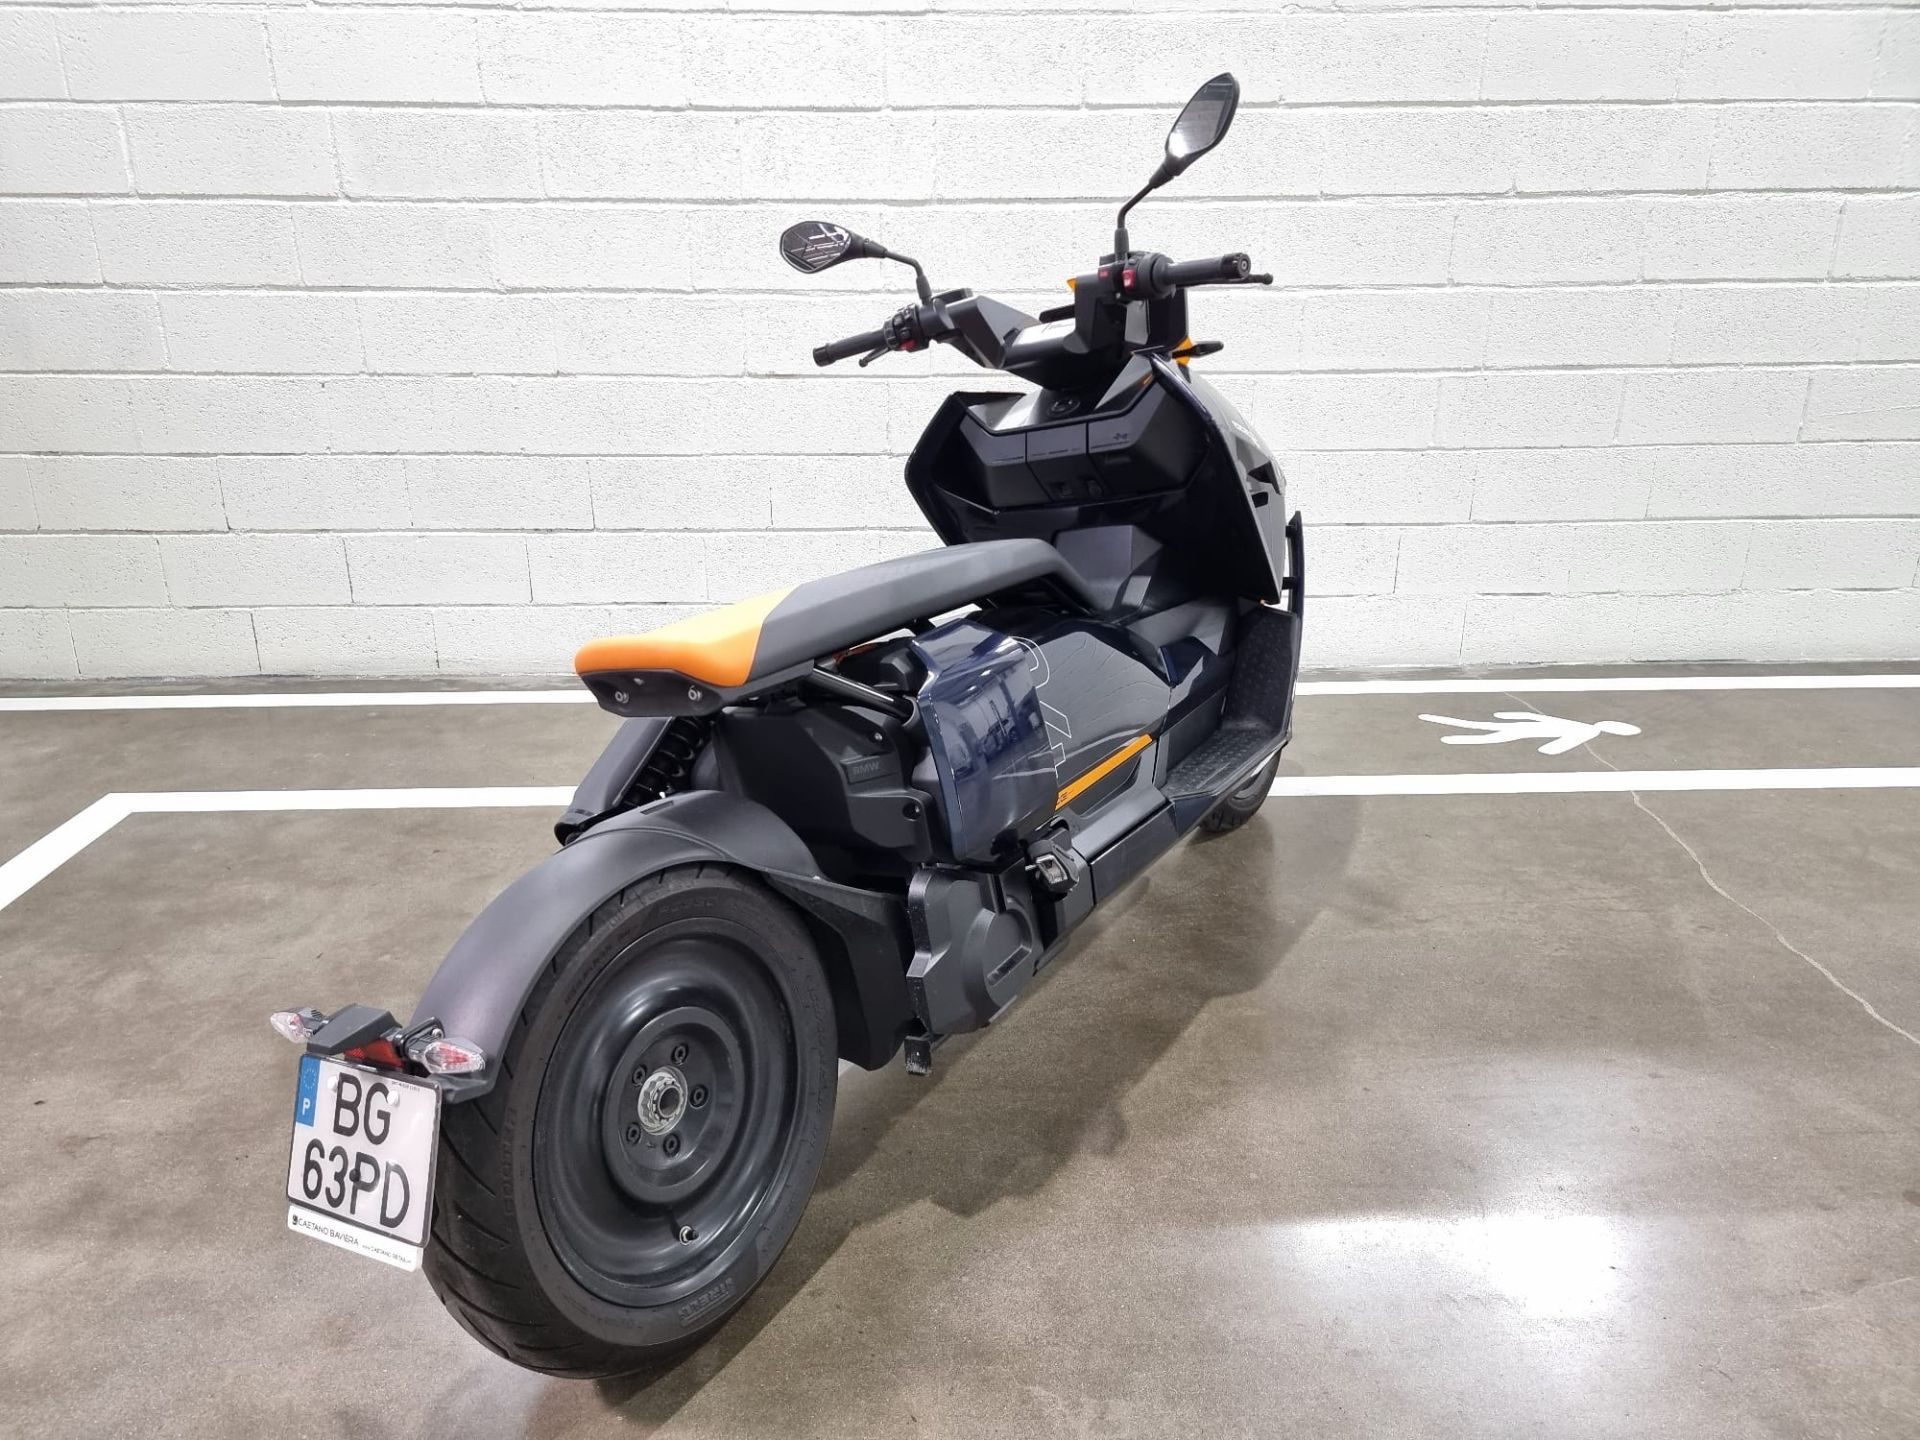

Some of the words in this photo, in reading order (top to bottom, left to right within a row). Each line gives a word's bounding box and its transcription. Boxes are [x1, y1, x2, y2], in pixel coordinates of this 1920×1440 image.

[302, 1097, 311, 1116] P
[333, 1071, 392, 1145] BG
[302, 1138, 411, 1228] 63PD
